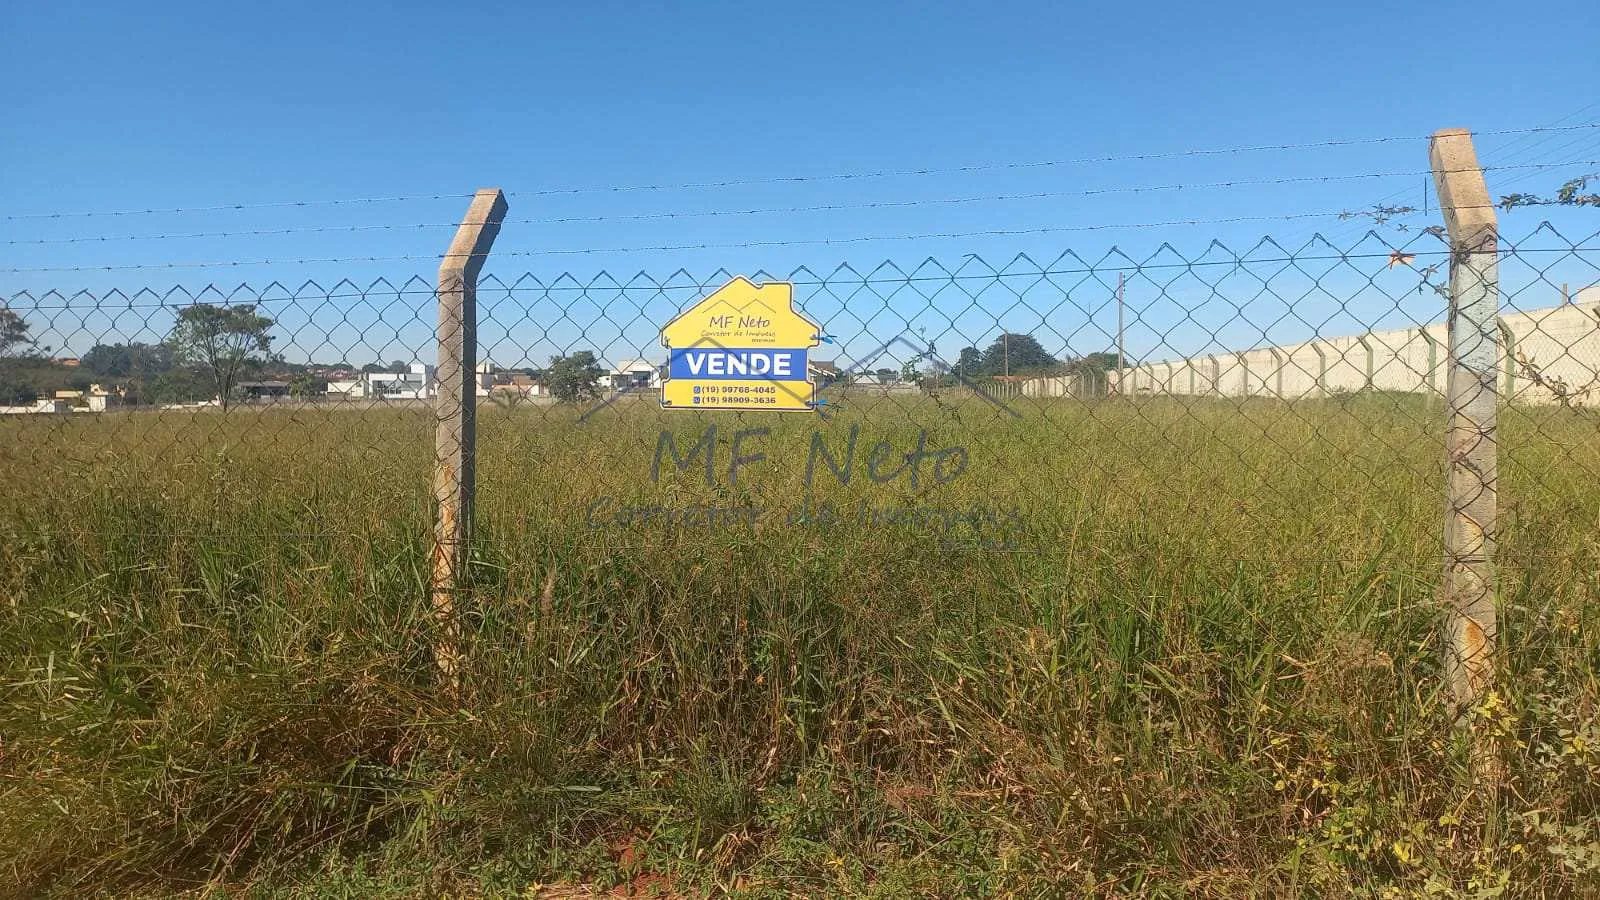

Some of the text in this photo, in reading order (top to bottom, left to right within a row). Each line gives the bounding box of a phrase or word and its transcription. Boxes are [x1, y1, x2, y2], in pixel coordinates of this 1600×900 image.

[709, 315, 770, 328] MF Neto
[686, 353, 792, 376] VENDE
[702, 386, 720, 394] (19)
[702, 396, 720, 404] (19)
